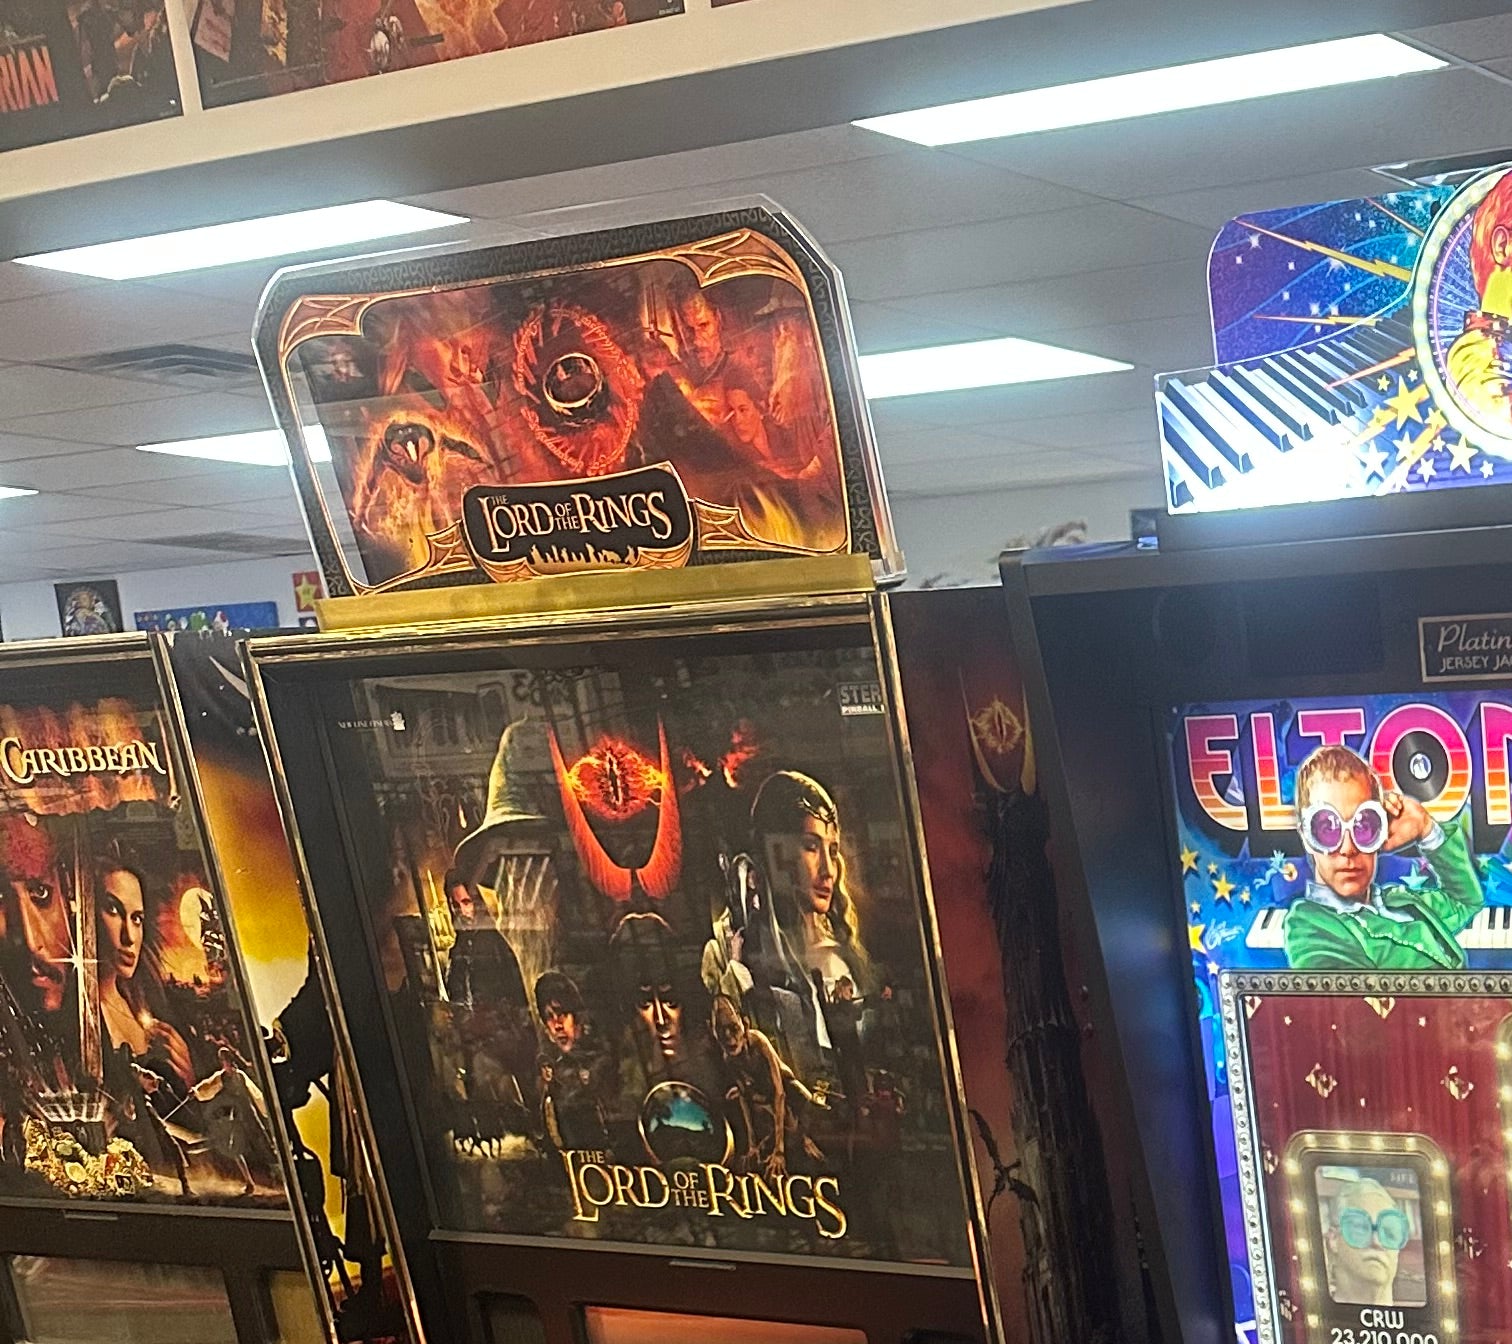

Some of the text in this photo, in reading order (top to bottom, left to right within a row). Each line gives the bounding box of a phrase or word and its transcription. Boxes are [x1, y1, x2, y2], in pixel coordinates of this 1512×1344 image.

[491, 495, 508, 505] THE
[478, 491, 672, 553] LORD OF THE RINGS
[1440, 654, 1489, 672] JERSEY
[840, 684, 882, 703] STER
[0, 737, 166, 784] CARIBBEAN
[578, 1152, 604, 1163] THE
[559, 1150, 847, 1239] LORD OF THE RINGS
[1360, 1308, 1404, 1329] CRW
